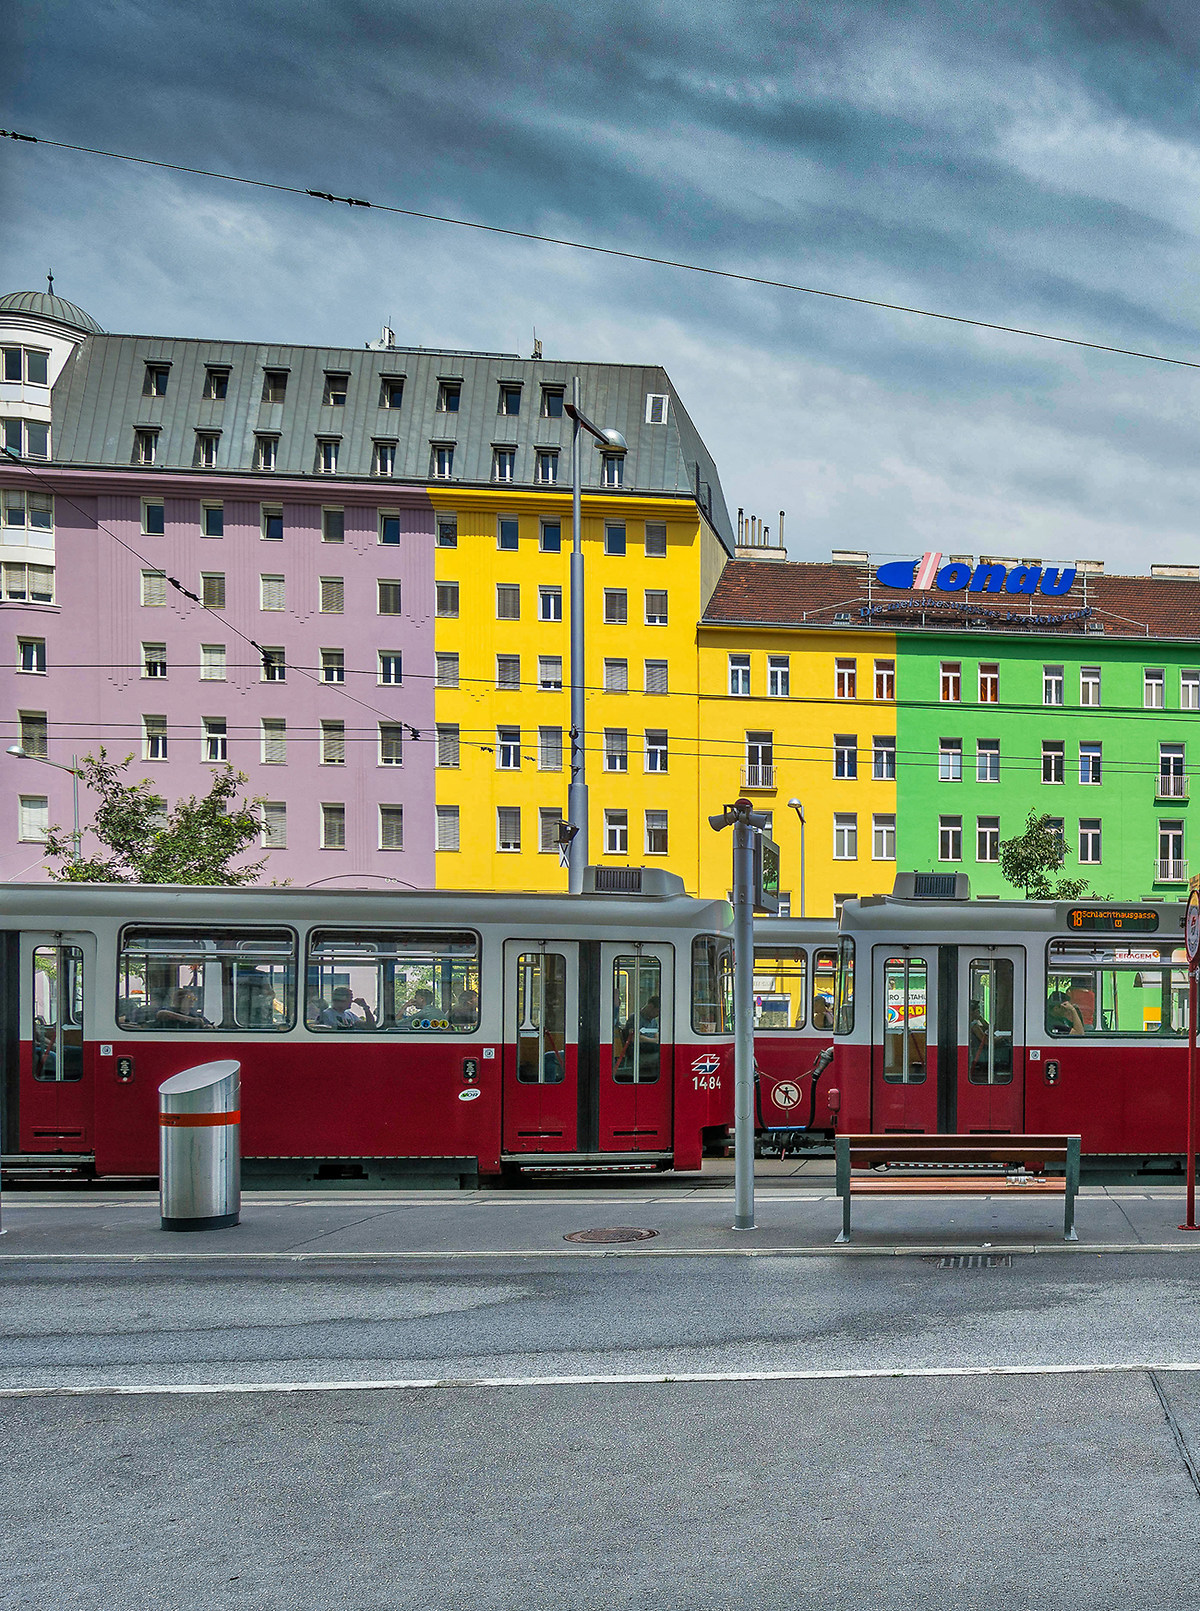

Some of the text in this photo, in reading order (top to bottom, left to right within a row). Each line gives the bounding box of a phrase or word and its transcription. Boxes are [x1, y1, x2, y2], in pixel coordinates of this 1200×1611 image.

[860, 604, 883, 617] Die
[1072, 910, 1156, 927] 18 Schlachthausgasse
[691, 1076, 722, 1090] 1484
